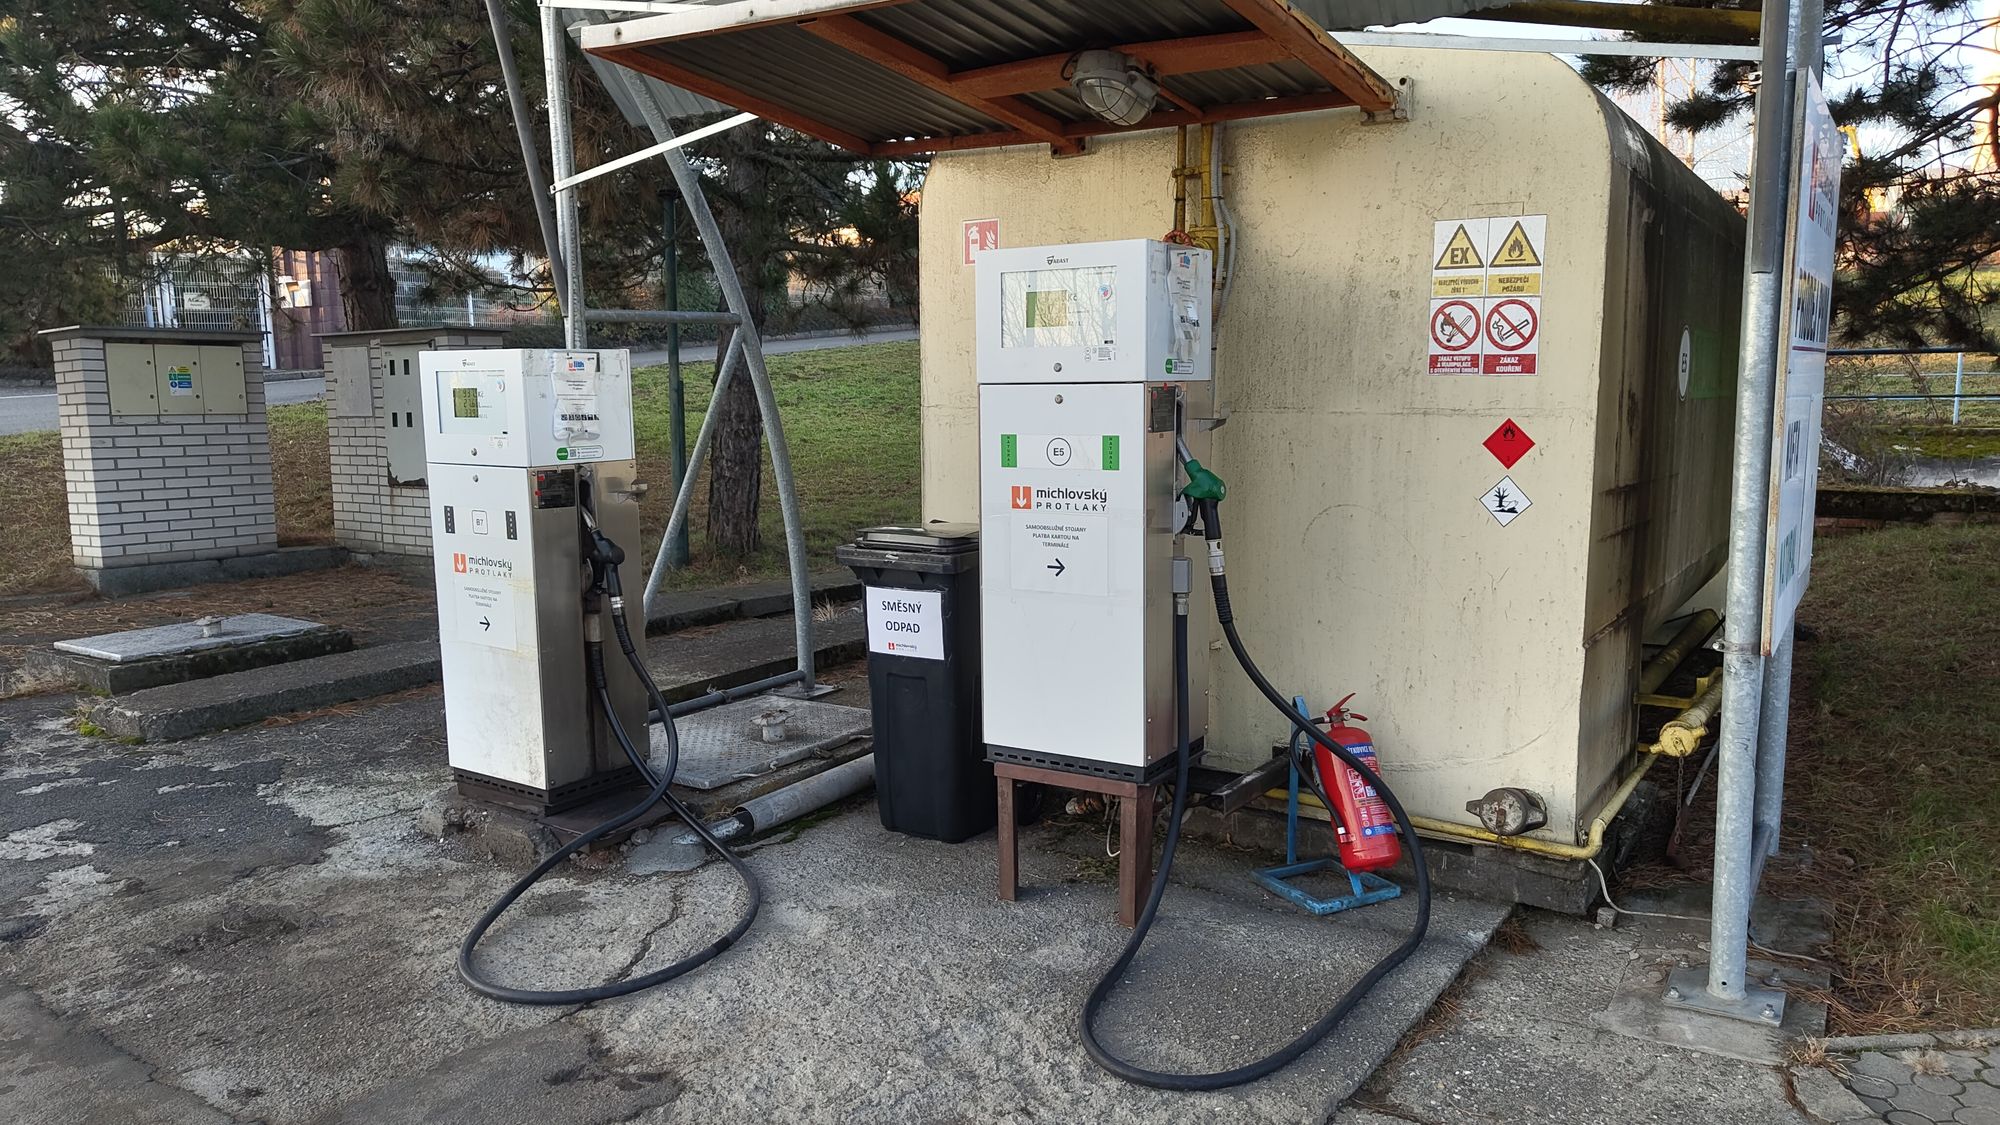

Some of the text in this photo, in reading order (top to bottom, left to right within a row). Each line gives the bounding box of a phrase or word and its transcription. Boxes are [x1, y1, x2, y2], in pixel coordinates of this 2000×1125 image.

[1450, 247, 1470, 265] EX
[1499, 356, 1519, 364] ZÁKAZ
[1495, 364, 1522, 373] KOUŘENÍ
[1053, 447, 1065, 457] E5
[1036, 487, 1107, 503] michlovský
[1036, 501, 1107, 512] PROTLAKY
[476, 518, 484, 526] B7
[469, 556, 512, 571] michlovský
[469, 567, 512, 579] PROTLAKY
[881, 599, 922, 613] SMĚSNÝ
[885, 620, 921, 634] ODPAD
